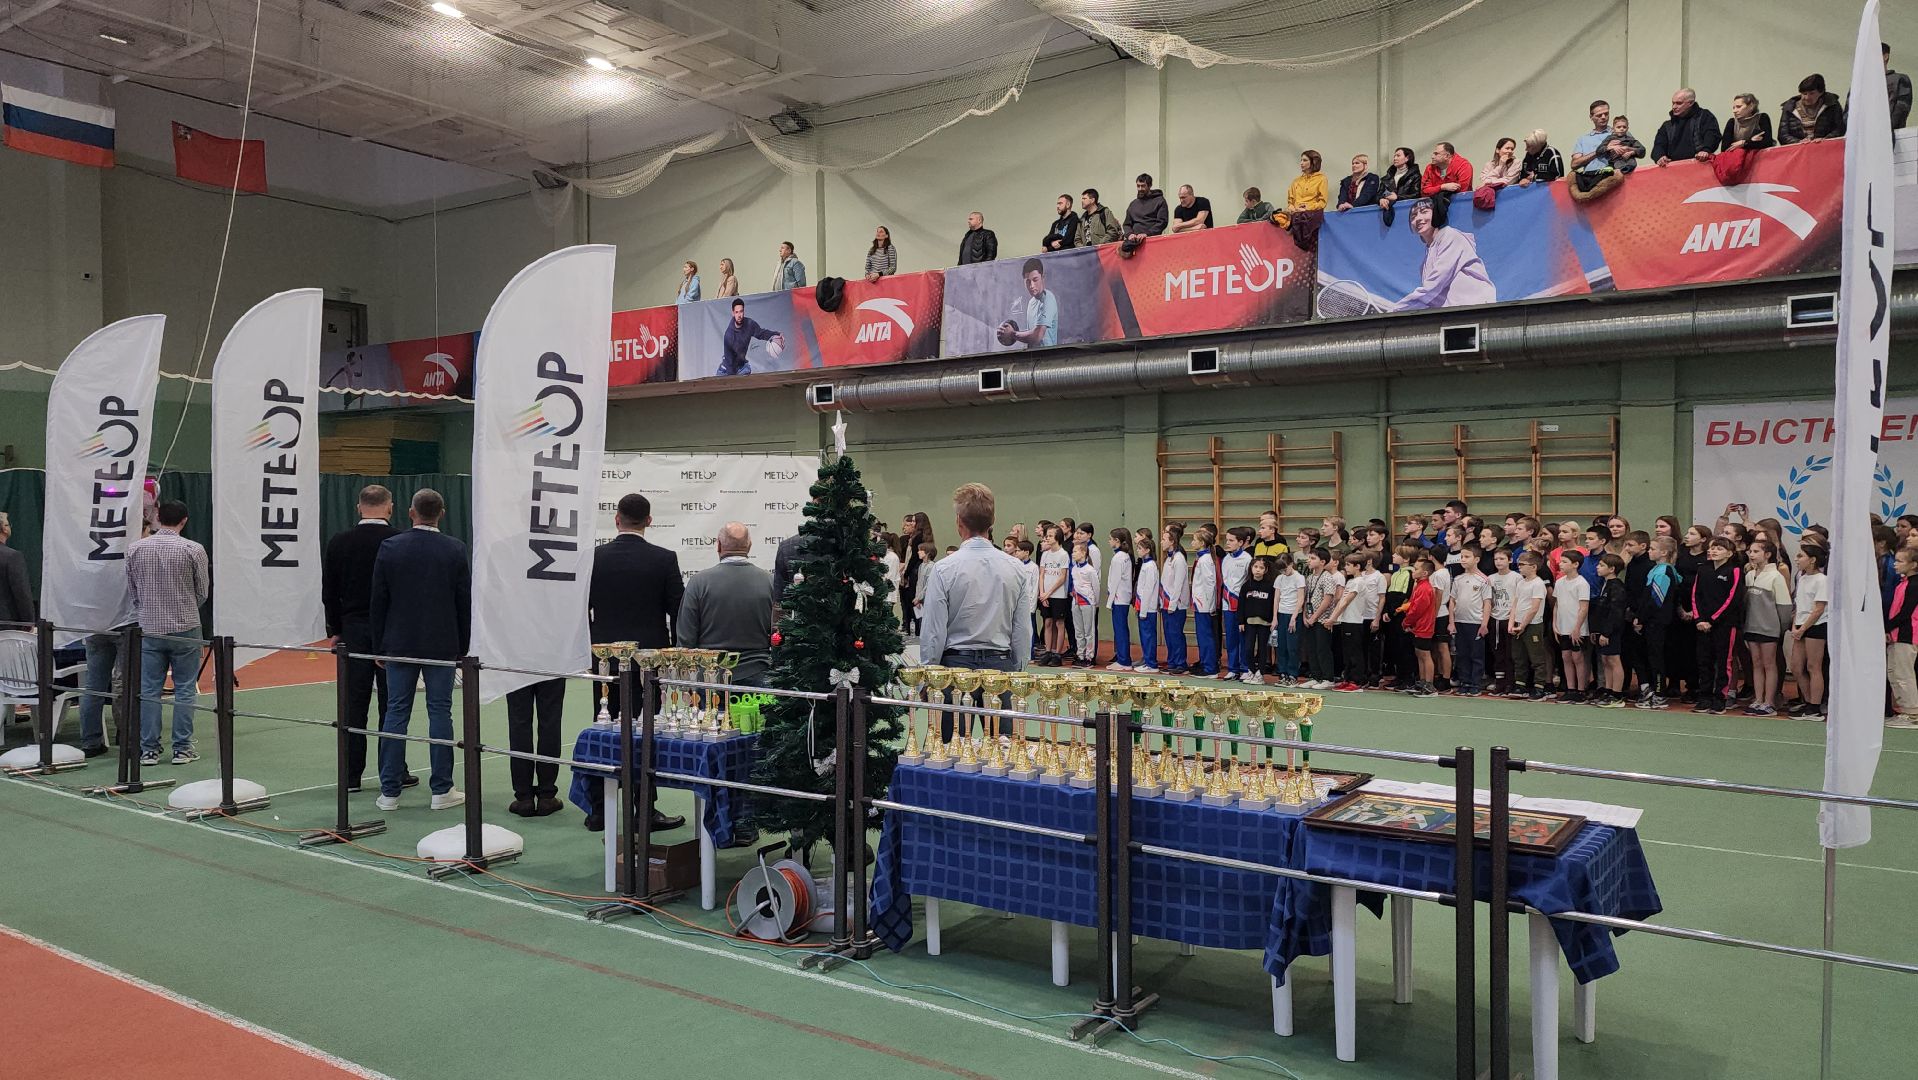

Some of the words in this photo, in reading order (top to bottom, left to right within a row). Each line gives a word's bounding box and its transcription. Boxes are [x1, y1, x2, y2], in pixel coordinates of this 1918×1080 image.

[1680, 217, 1761, 254] ANTA
[1165, 257, 1294, 302] МЕТЕОР
[854, 321, 892, 343] ANTA
[422, 370, 445, 388] ANTA
[1705, 412, 1918, 447] БЫСТЕ!
[260, 378, 305, 568] МЕТЕОР
[526, 351, 584, 582] МЕТЕОР
[601, 469, 632, 480] ЕТЕОР
[681, 469, 718, 480] МЕТЕОР
[764, 470, 799, 480] МЕТЕОР
[87, 395, 139, 561] МЕТЕОР
[681, 502, 718, 511] МЕТЕОР
[764, 501, 800, 511] МЕТЕОР
